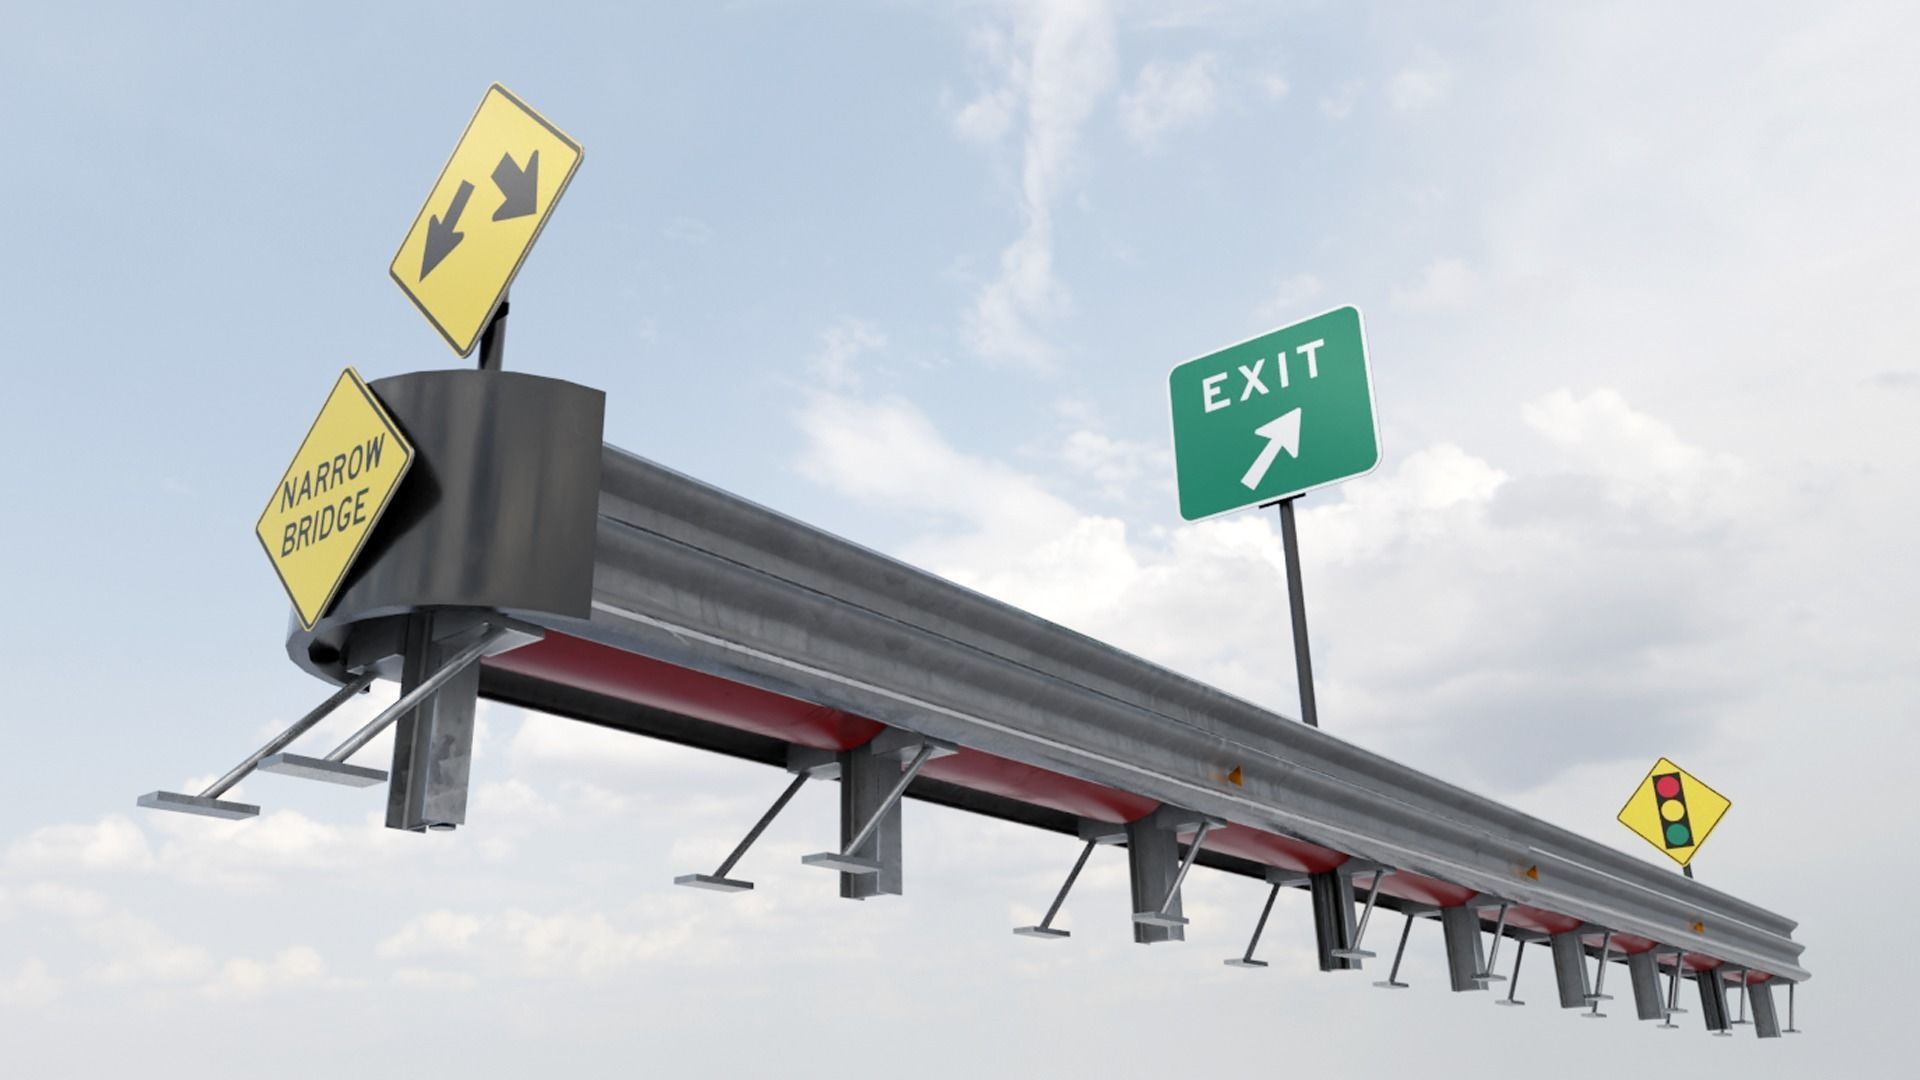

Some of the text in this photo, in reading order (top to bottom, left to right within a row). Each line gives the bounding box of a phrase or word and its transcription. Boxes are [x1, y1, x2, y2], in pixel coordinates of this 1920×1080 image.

[1202, 338, 1325, 413] EXIT
[280, 432, 385, 513] NARROW
[281, 487, 370, 558] BRIDGE
